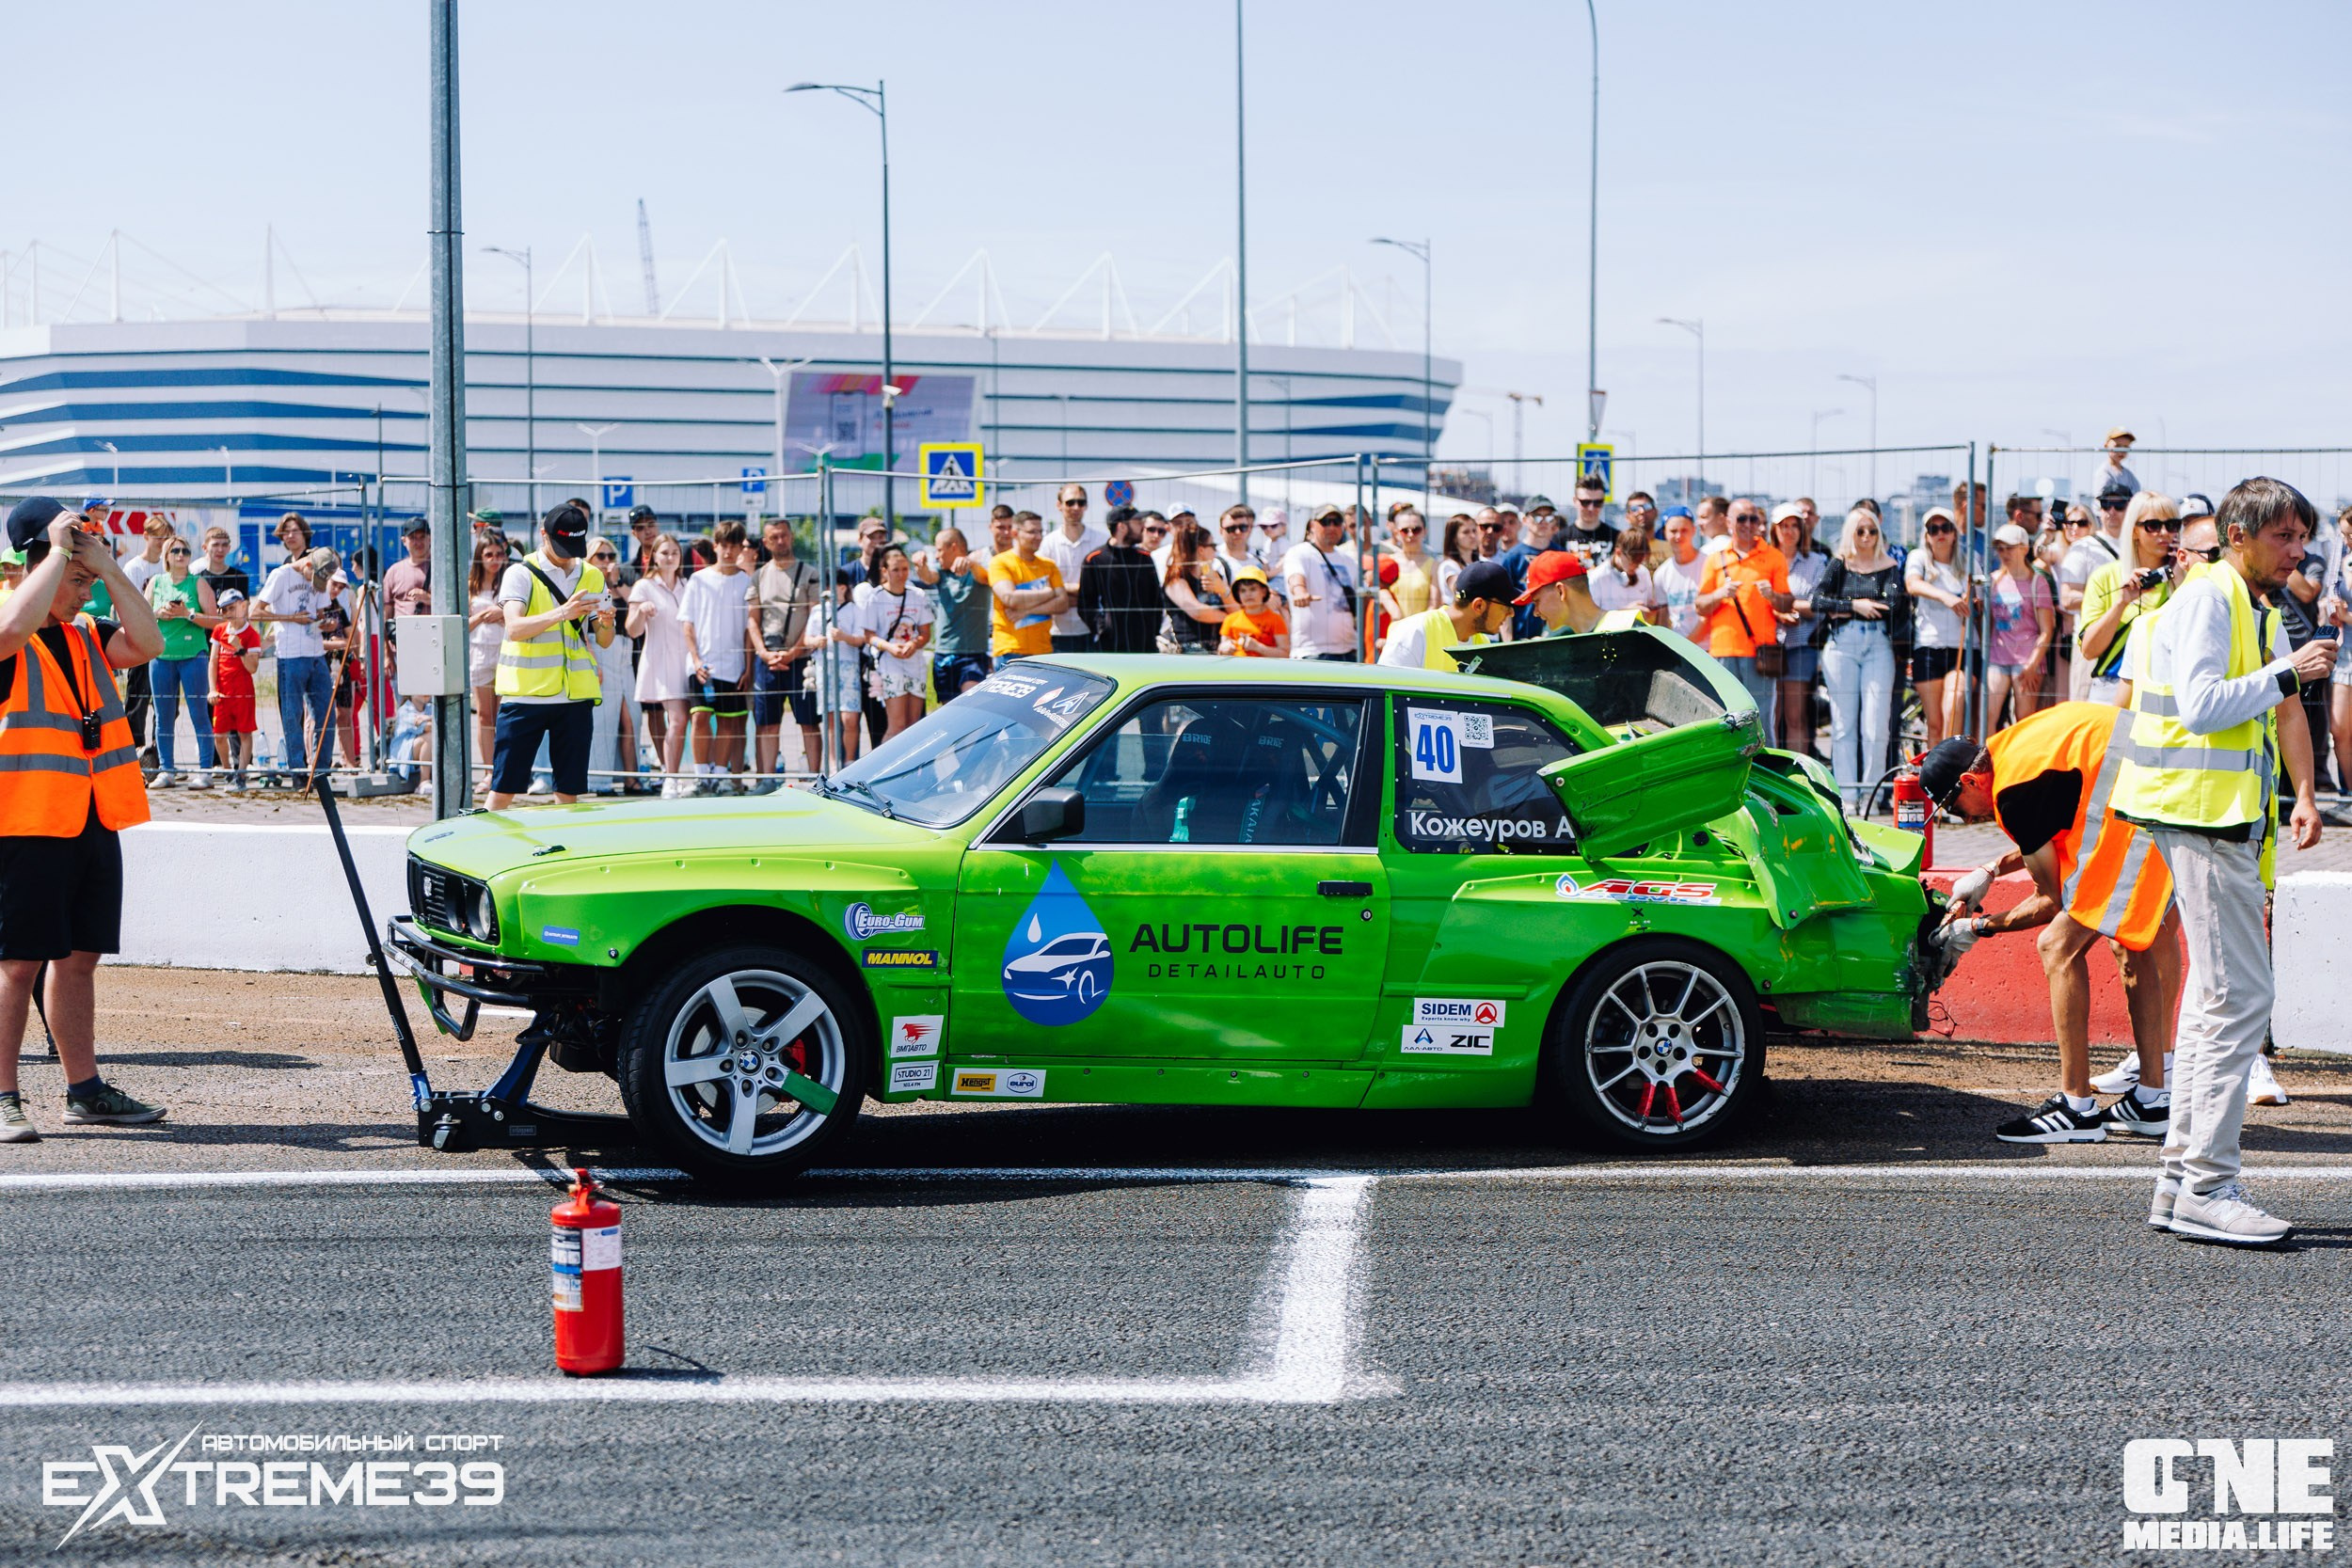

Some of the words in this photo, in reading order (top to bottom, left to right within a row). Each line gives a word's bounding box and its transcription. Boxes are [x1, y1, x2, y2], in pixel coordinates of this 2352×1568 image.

[1416, 724, 1454, 774] 40
[1411, 812, 1547, 842] Кожеуров
[1581, 879, 1716, 897] AGS
[1129, 924, 1343, 955] AUTOLIFE
[867, 953, 932, 964] MANNOL
[1149, 964, 1325, 979] DETAILAUTO
[1422, 1003, 1471, 1016] SIDEM
[1450, 1035, 1490, 1049] ZIC
[898, 1069, 922, 1079] STUDIO
[923, 1069, 930, 1077] 21
